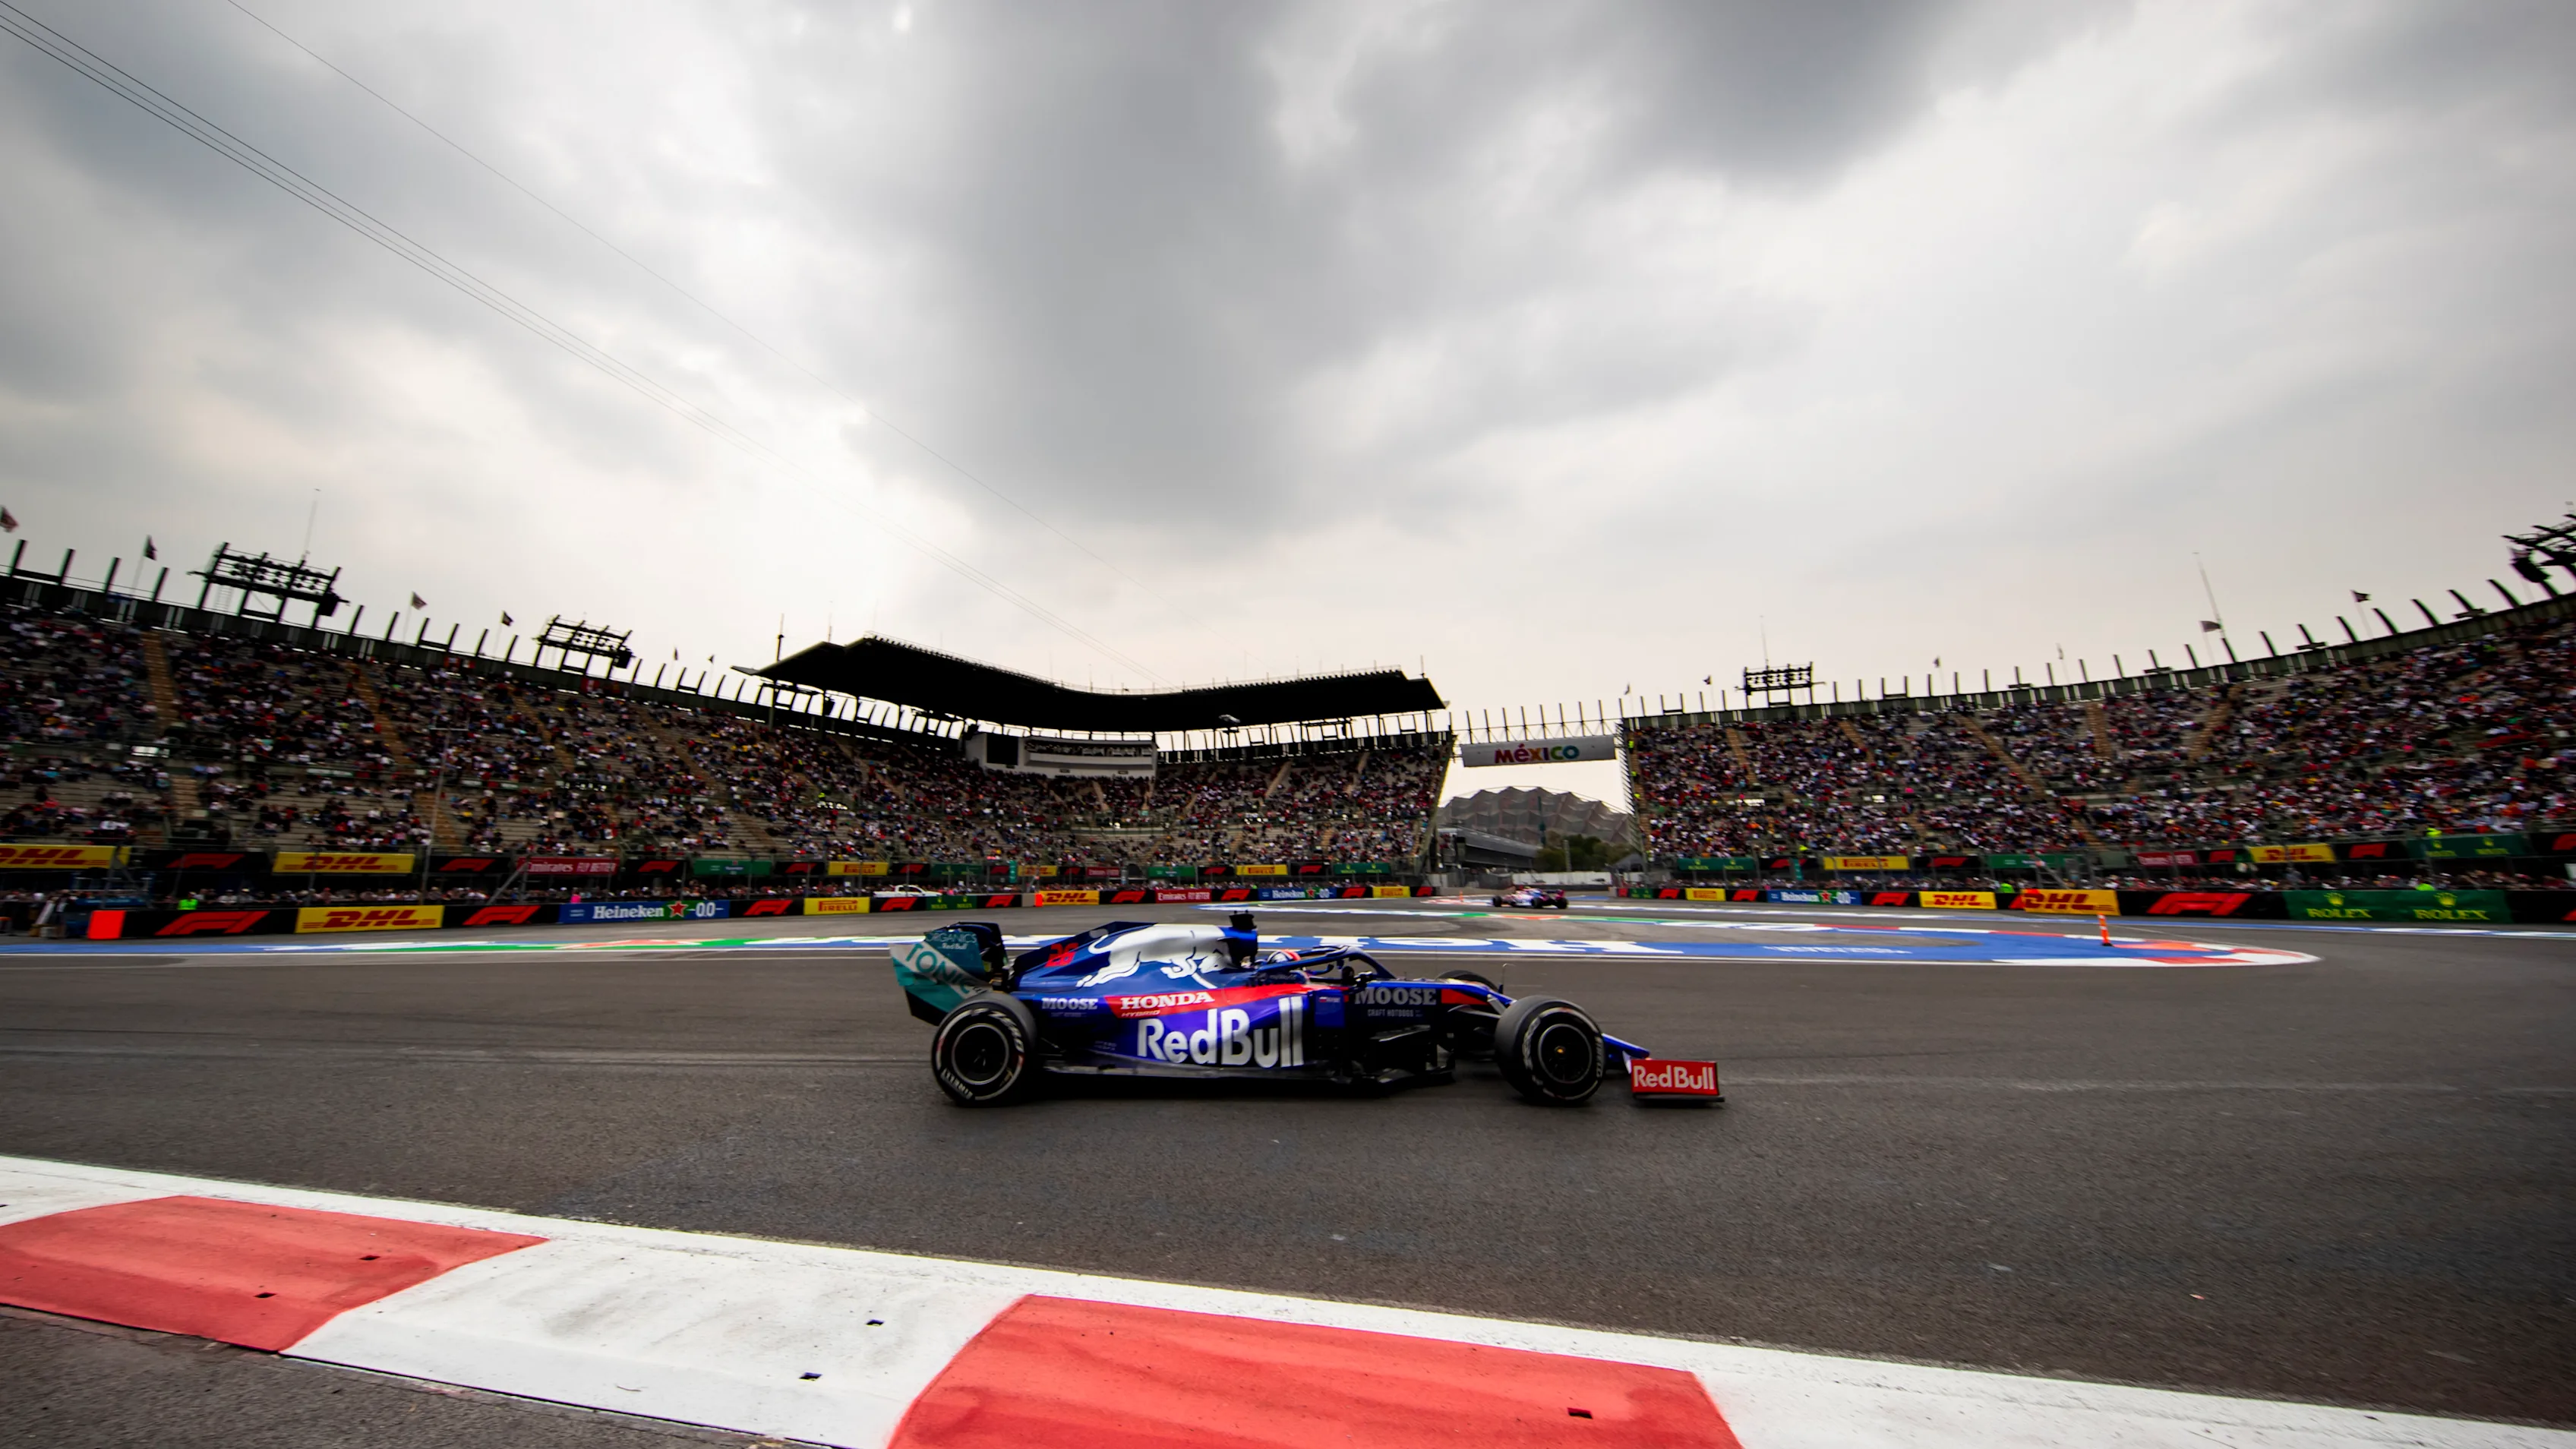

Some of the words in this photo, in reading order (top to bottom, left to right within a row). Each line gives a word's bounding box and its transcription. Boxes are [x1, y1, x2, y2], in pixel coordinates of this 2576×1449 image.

[303, 856, 384, 870] DHL
[1046, 892, 1089, 903] DHL
[1780, 891, 1820, 902] Heineken
[1933, 894, 1982, 906] DHL
[2023, 892, 2099, 911] DHL
[592, 904, 665, 920] Heineken
[818, 900, 858, 911] PIRELLI
[323, 910, 419, 928] DHL
[2306, 908, 2373, 919] ROLEX
[2413, 908, 2490, 920] ROLEX
[925, 932, 977, 942] ORGANICS
[1120, 991, 1215, 1010] HONDA
[1354, 987, 1436, 1005] MOOSE
[1041, 997, 1098, 1011] MOOSE
